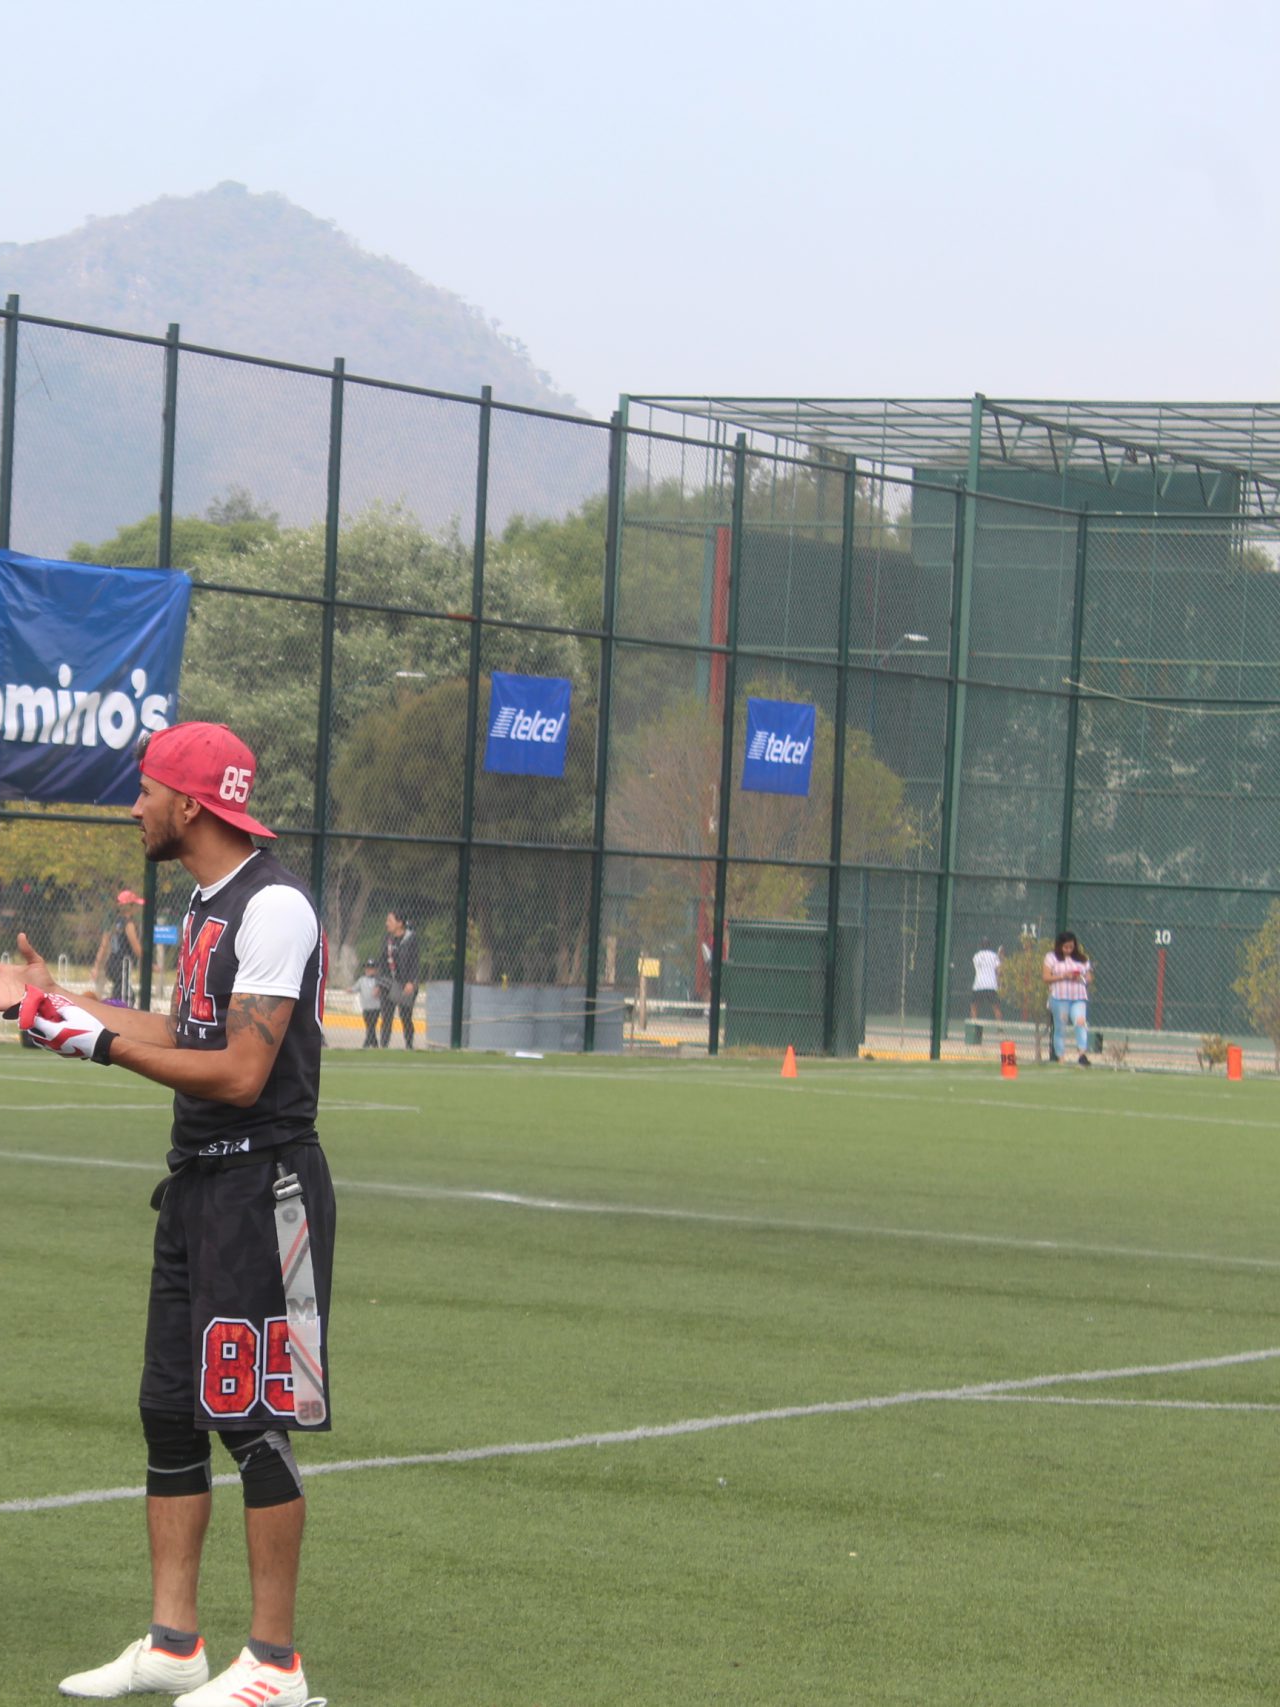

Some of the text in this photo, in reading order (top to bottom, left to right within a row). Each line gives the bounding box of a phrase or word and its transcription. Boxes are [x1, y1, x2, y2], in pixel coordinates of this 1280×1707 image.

[510, 708, 566, 743] telcel
[765, 732, 811, 765] telcel
[219, 765, 252, 803] 85
[1154, 929, 1171, 945] 10
[176, 910, 228, 1026] M
